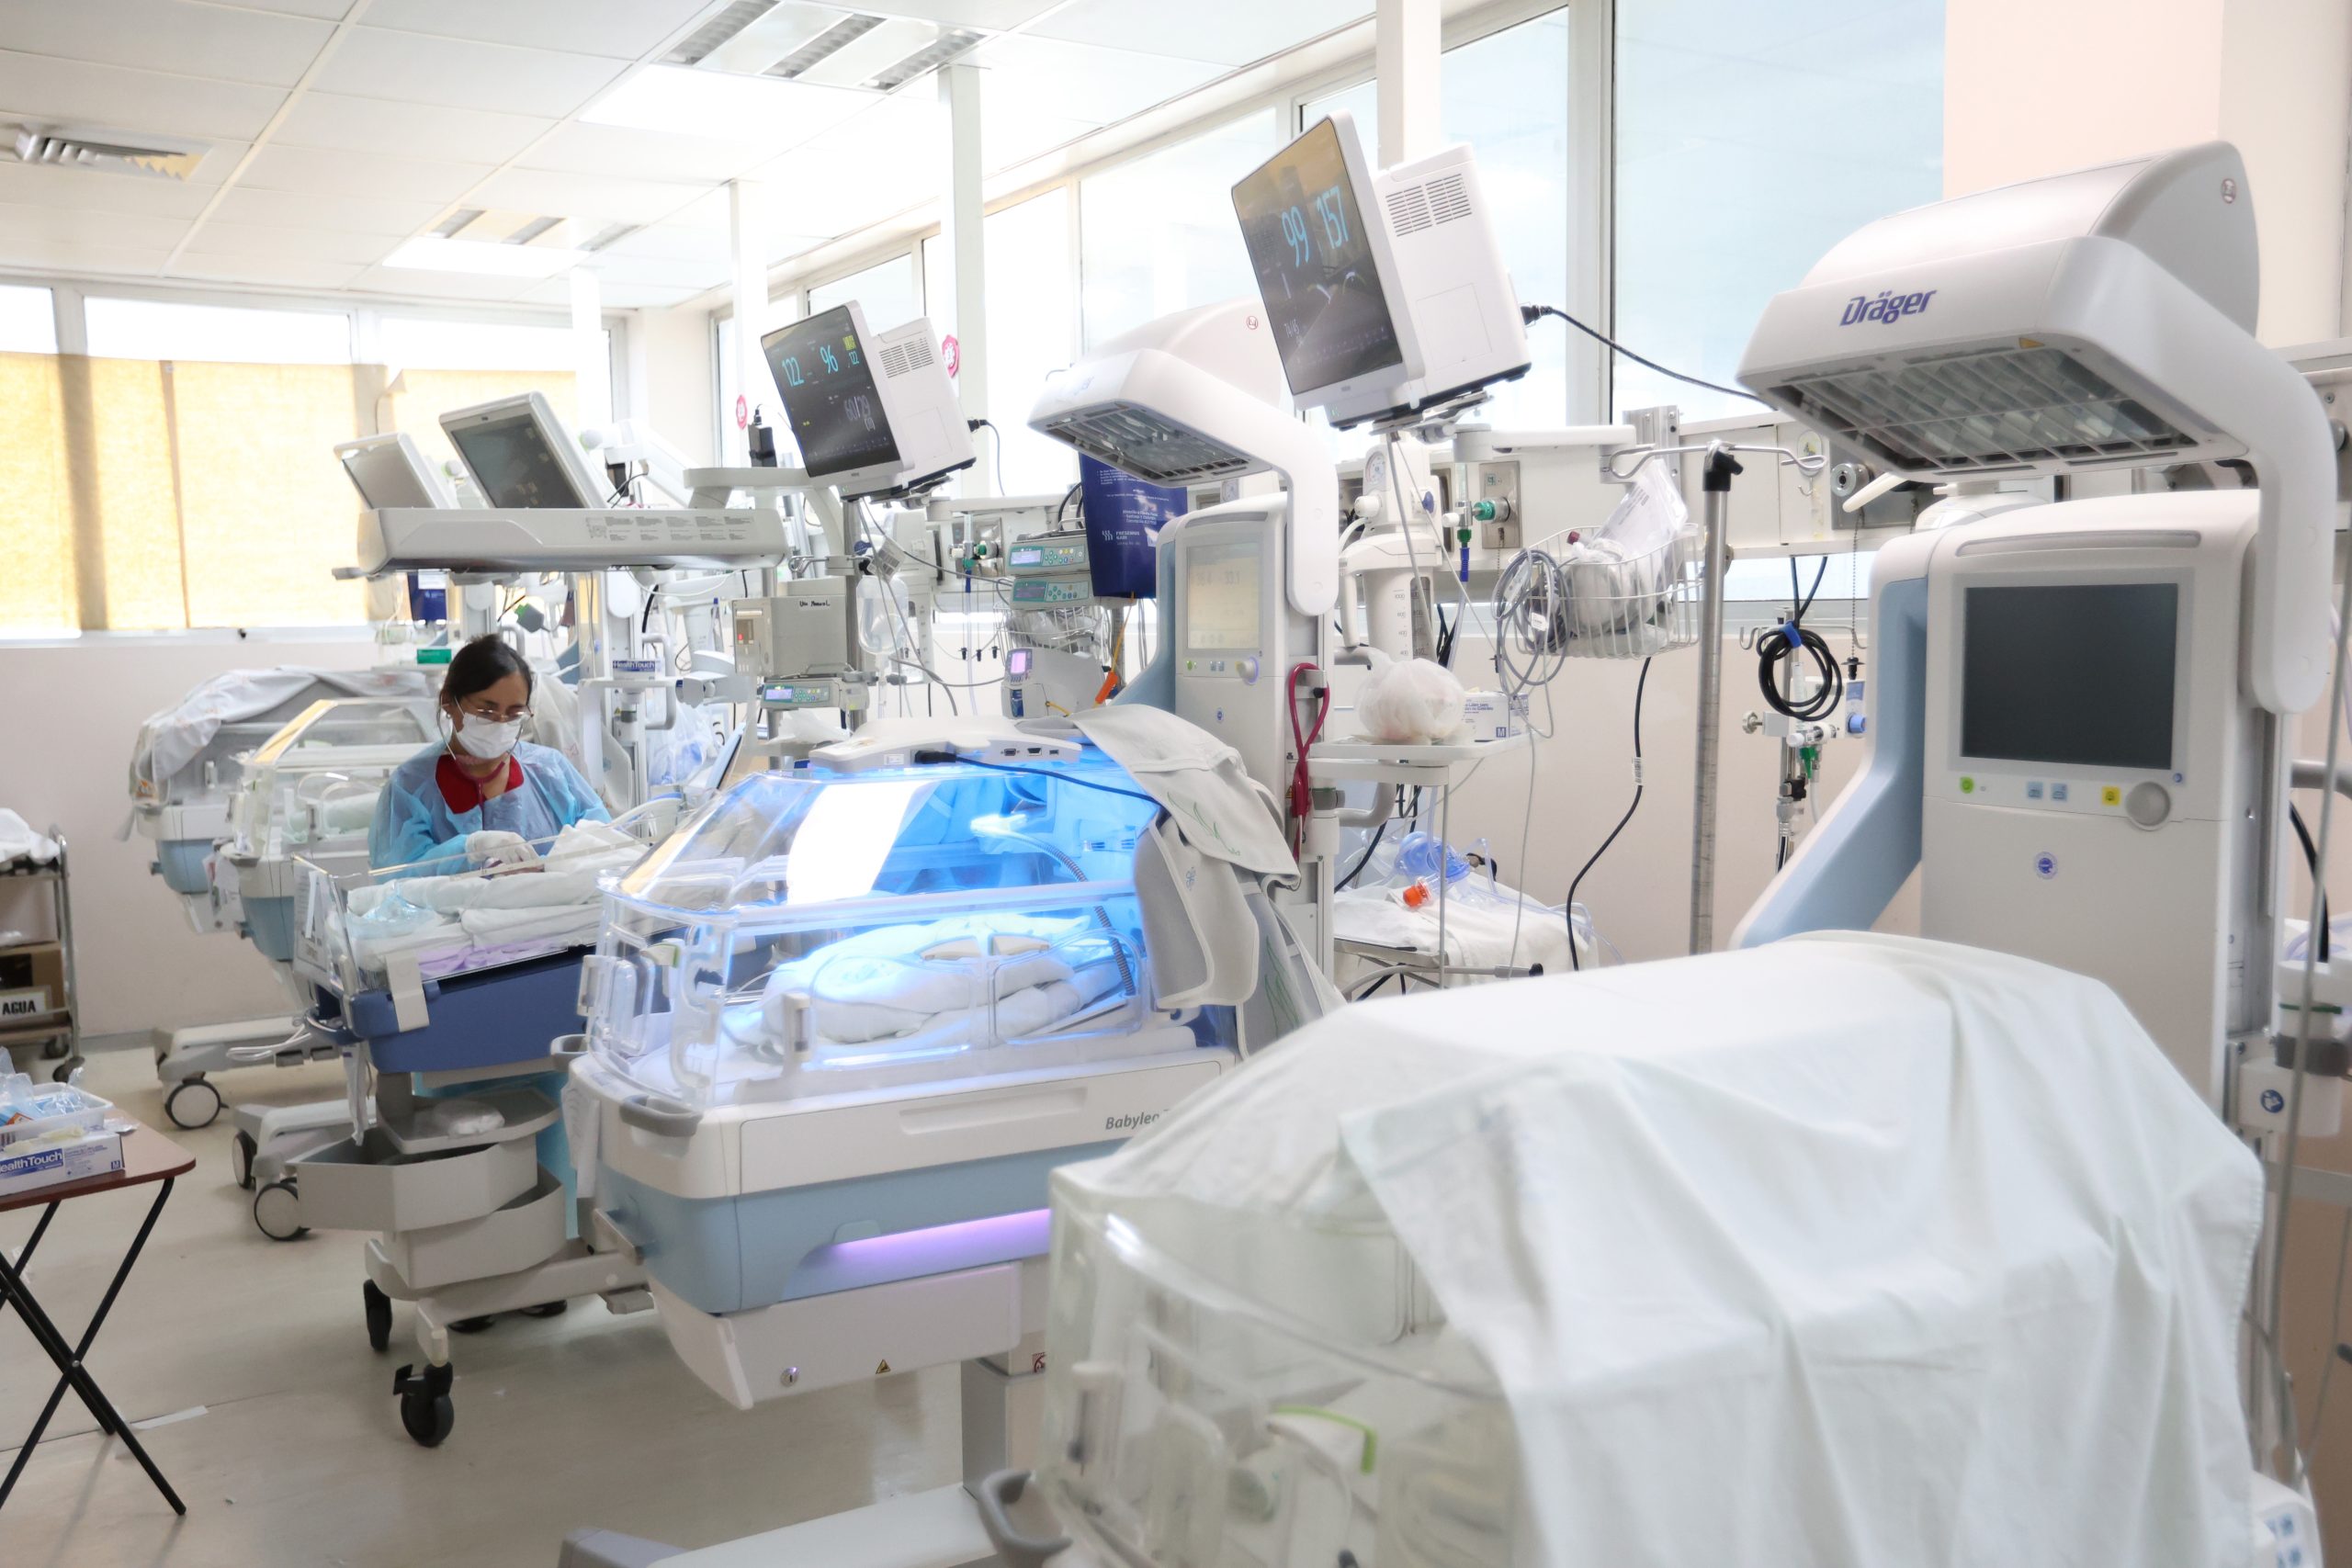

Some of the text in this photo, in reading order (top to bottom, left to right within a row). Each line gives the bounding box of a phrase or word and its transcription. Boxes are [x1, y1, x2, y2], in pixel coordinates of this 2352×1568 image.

[1317, 186, 1349, 249] 157
[1282, 206, 1309, 267] 99
[1839, 289, 1938, 326] Dräger
[782, 356, 805, 388] 122
[820, 344, 839, 375] 96
[3, 1000, 37, 1015] AGUA
[0, 1152, 62, 1173] ealthTouch
